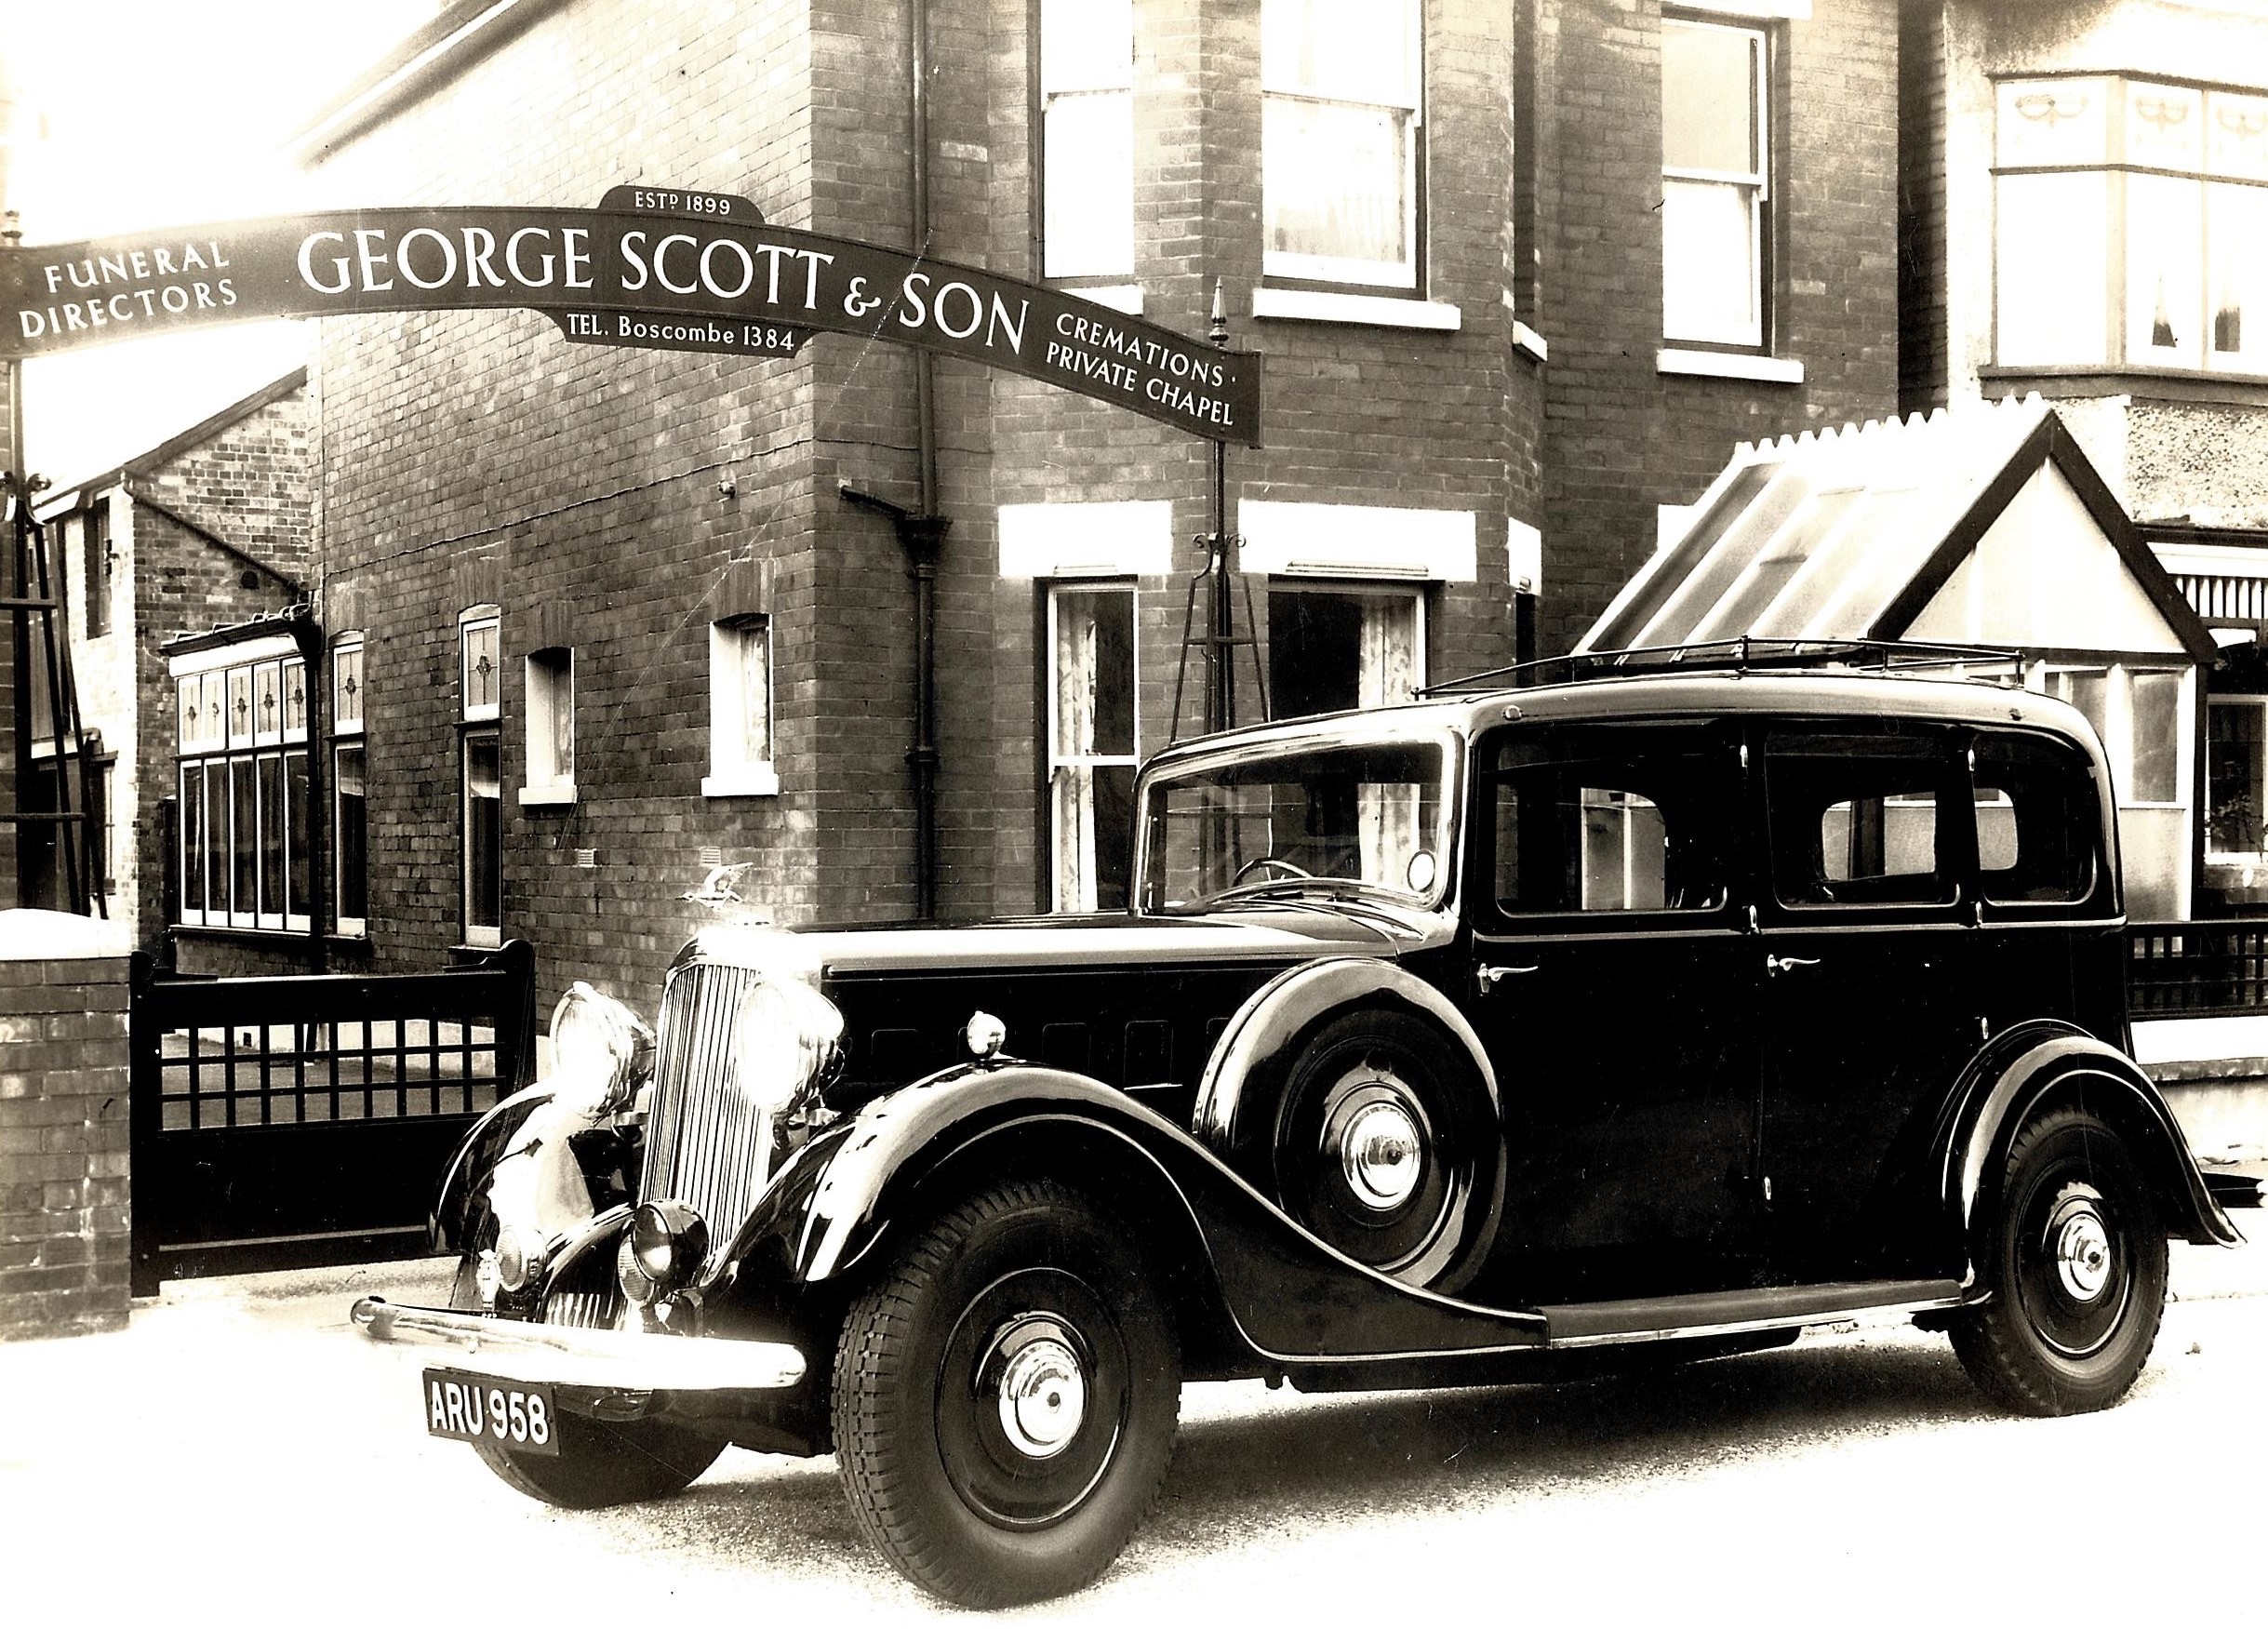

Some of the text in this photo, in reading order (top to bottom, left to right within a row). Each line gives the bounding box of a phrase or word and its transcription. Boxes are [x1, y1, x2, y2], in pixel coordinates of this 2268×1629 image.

[686, 195, 731, 215] 1899
[44, 241, 230, 294] FUNERAL
[297, 227, 1030, 355] GEORGE SCOTT & SON
[19, 278, 238, 339] DIRECTORS
[567, 313, 795, 351] TEL. Boscombe 1384
[1045, 340, 1234, 427] PRIVATE CHAPEL
[431, 1380, 550, 1446] ARU 958
